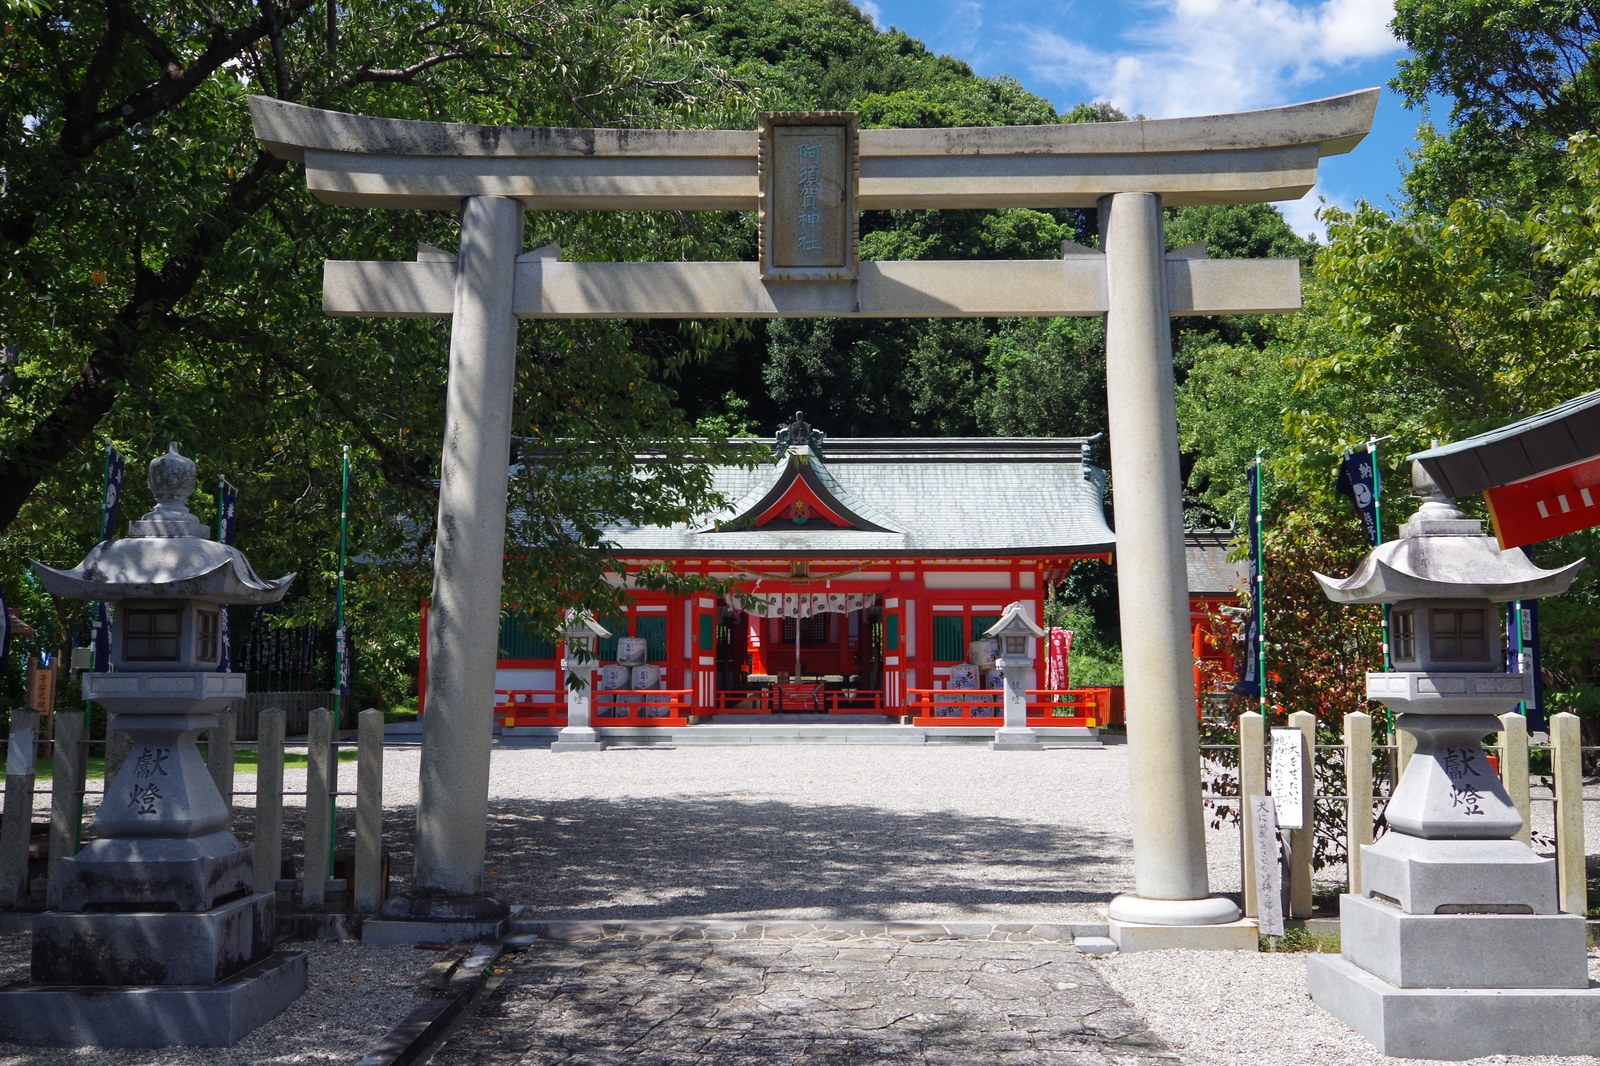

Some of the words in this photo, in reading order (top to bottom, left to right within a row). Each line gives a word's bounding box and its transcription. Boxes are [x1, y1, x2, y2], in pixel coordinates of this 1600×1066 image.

[797, 143, 822, 251] 阿須賀神社
